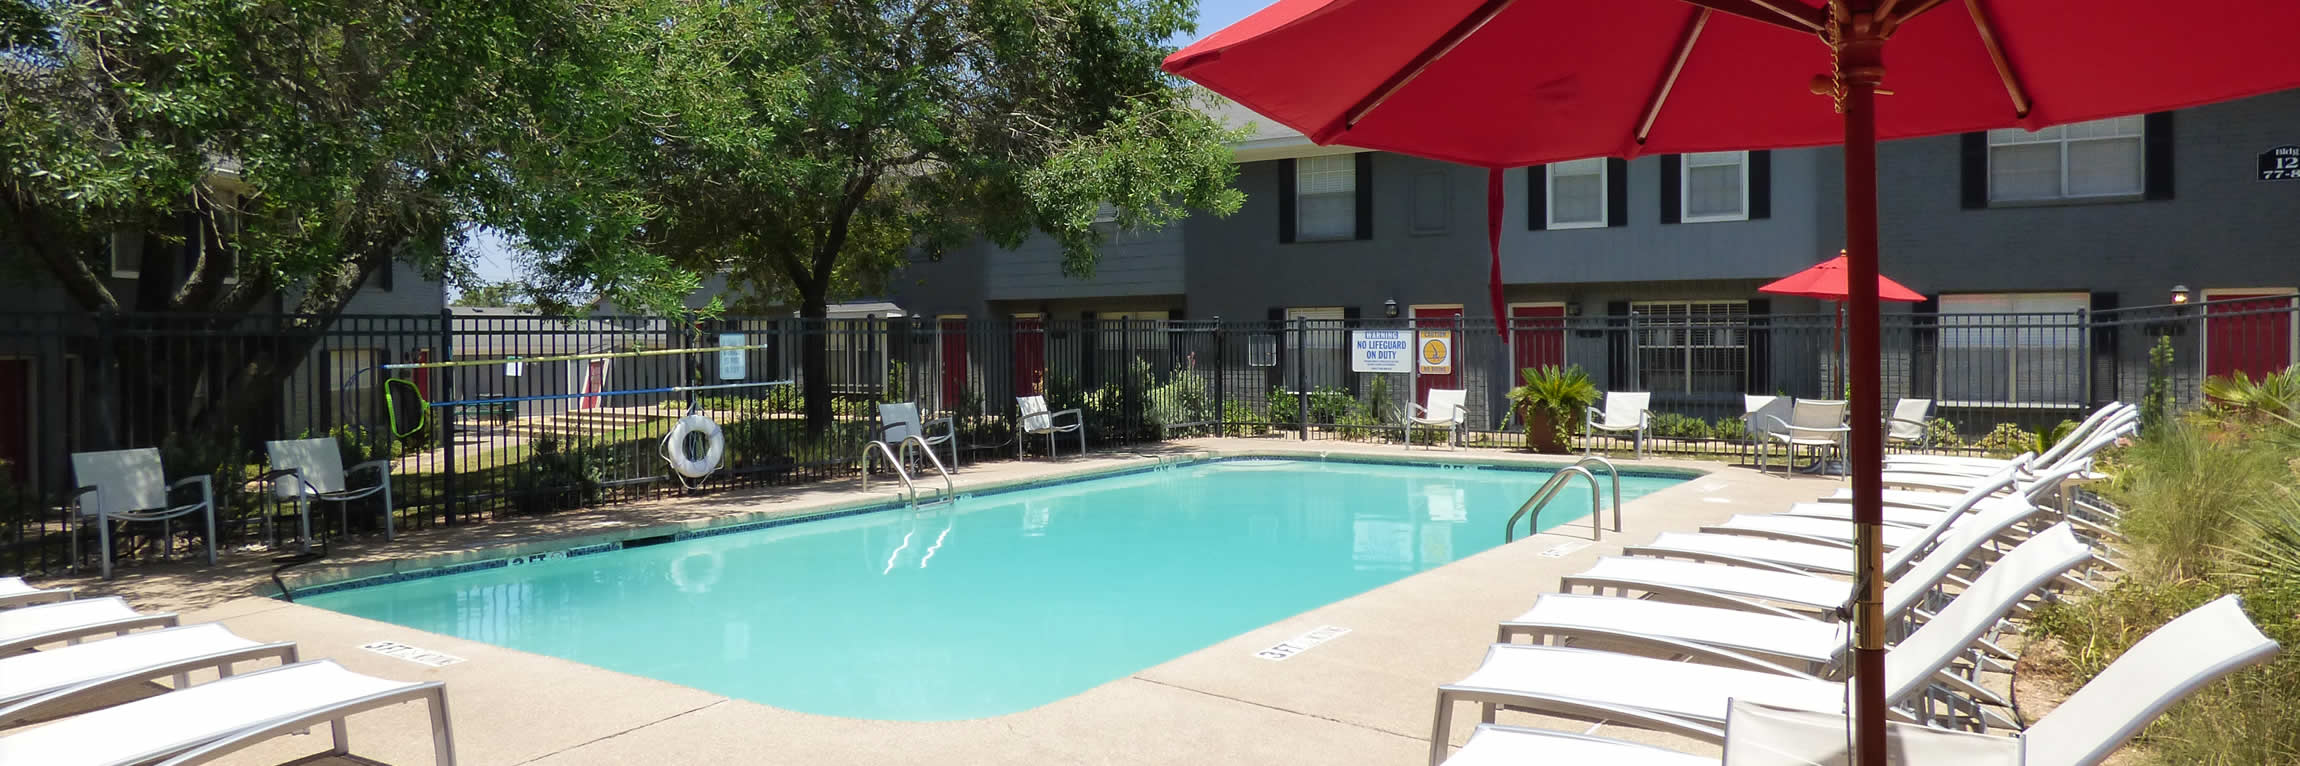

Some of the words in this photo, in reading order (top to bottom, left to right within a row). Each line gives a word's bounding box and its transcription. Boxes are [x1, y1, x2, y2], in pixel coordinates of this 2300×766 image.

[2276, 157, 2299, 169] 12
[1365, 331, 1399, 340] WARNING
[1357, 340, 1367, 349] NO
[1369, 341, 1407, 350] LIFEGUARD
[1366, 350, 1376, 359] ON
[1378, 350, 1397, 359] DUTY
